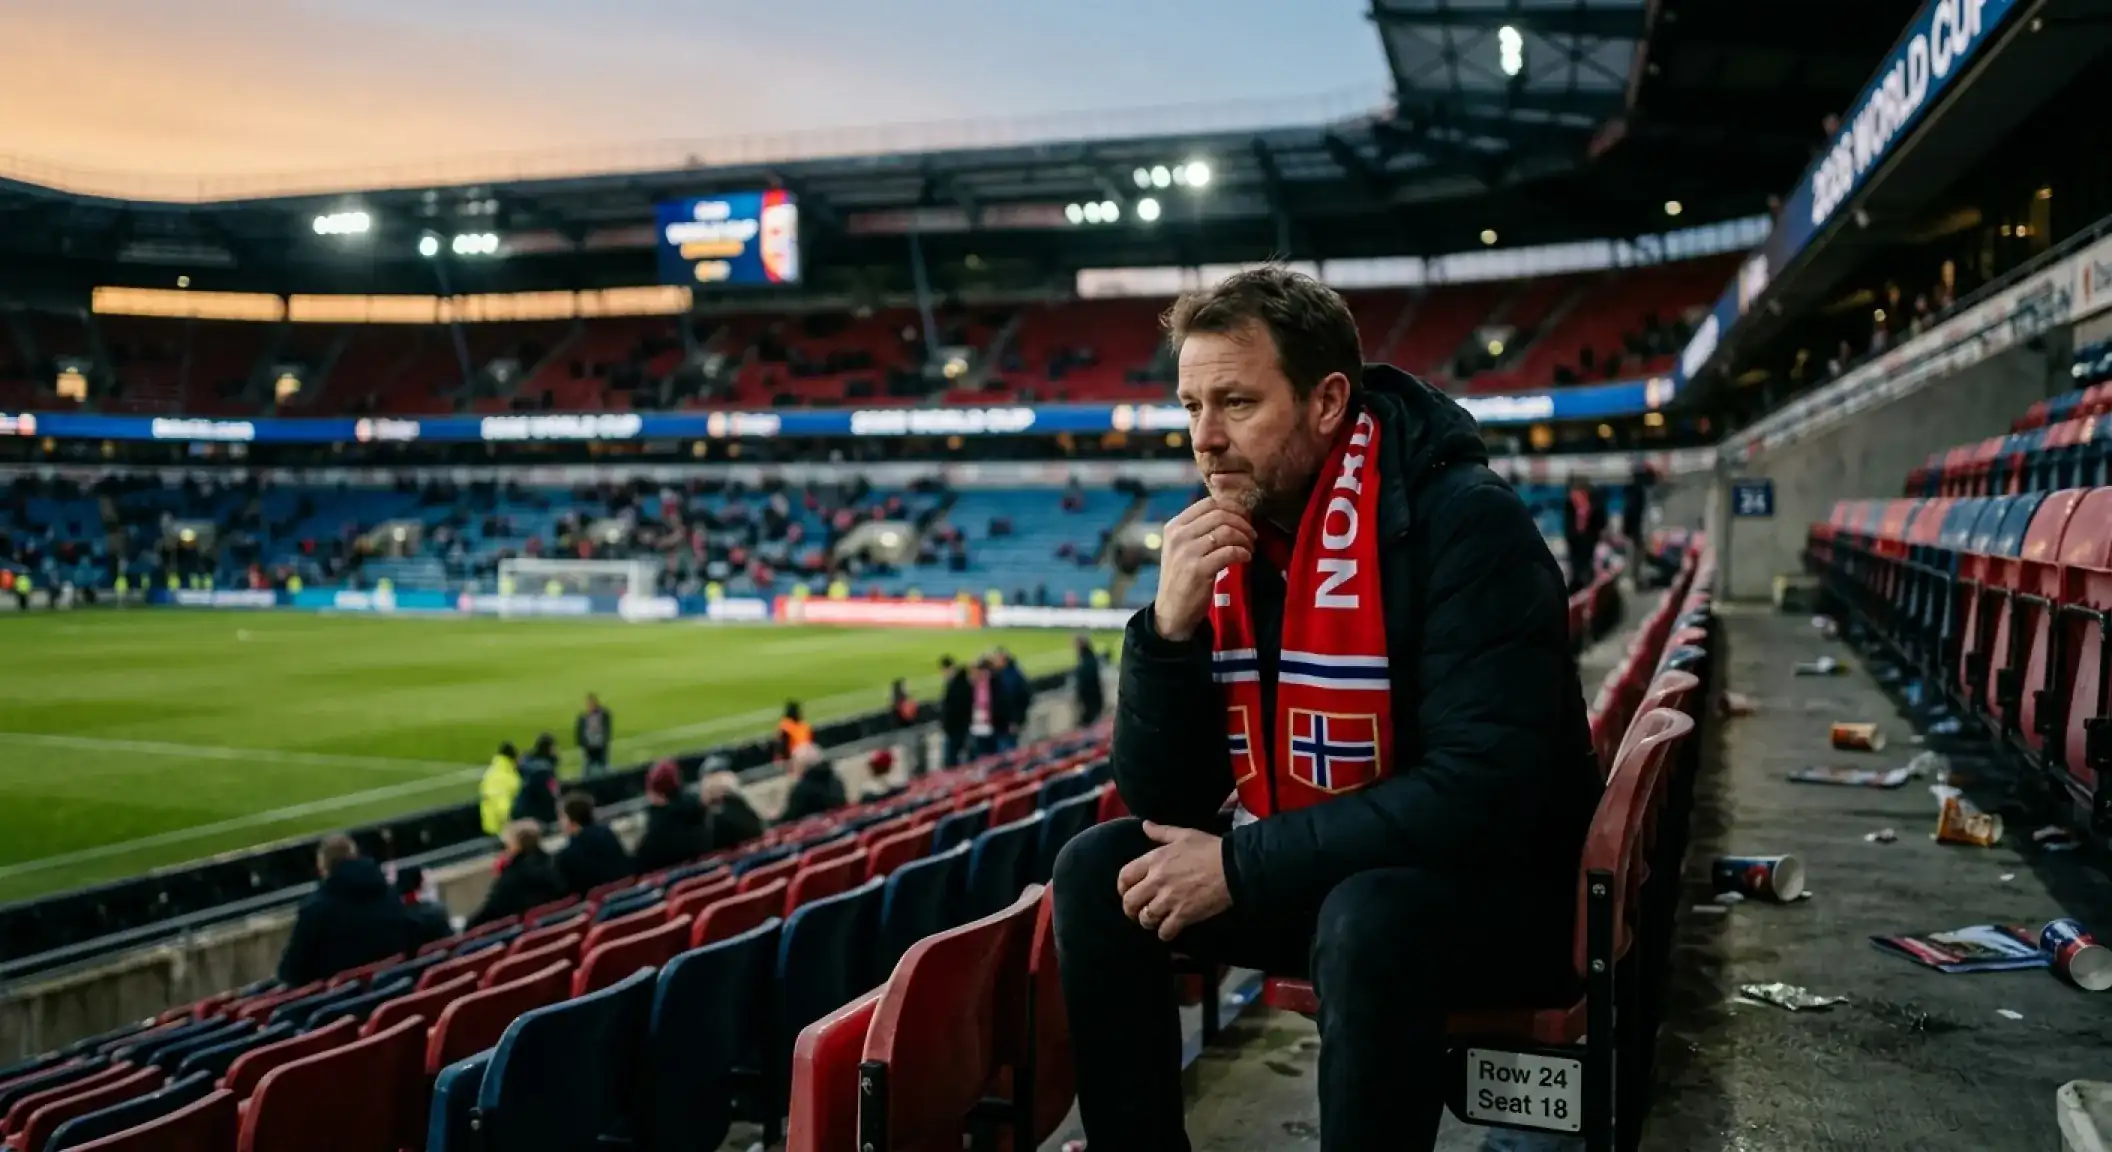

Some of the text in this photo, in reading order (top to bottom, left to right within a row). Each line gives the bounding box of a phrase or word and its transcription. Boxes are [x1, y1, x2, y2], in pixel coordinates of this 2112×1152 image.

[1852, 33, 1930, 175] WORLD
[1479, 1060, 1568, 1089] Row 24
[1478, 1088, 1568, 1119] Seat 18
